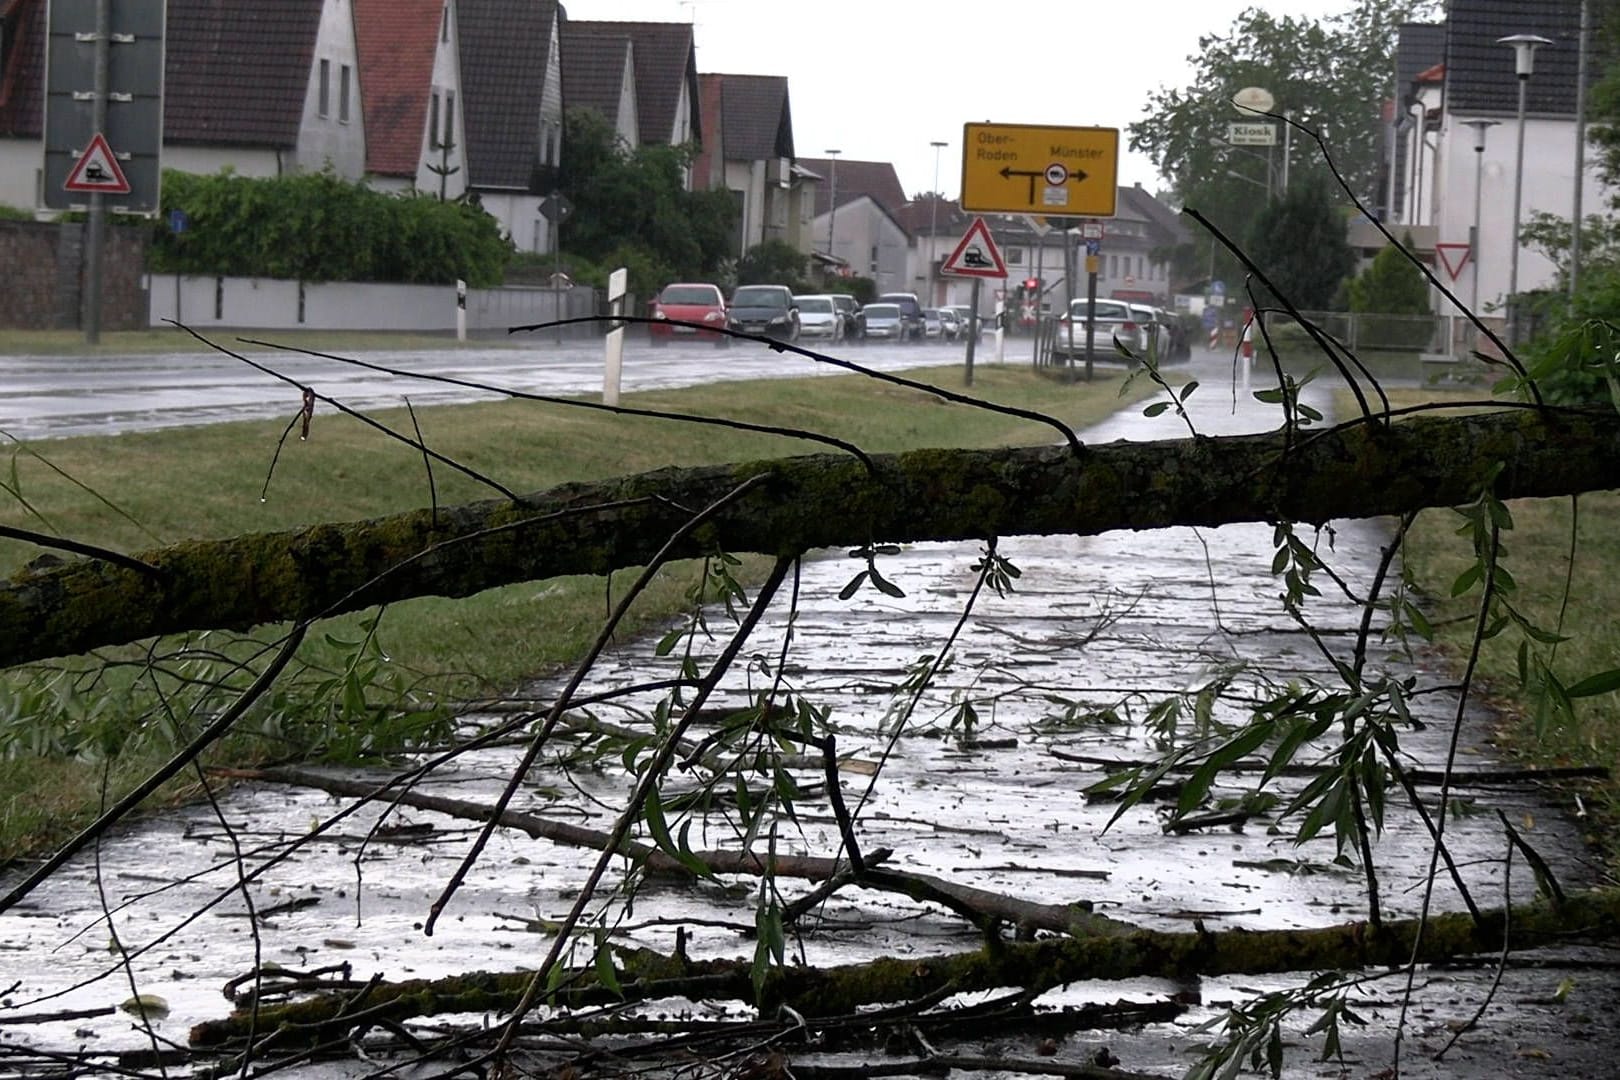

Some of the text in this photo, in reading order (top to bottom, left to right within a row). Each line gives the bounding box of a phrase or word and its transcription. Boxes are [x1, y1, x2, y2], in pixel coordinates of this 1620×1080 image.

[1234, 126, 1272, 136] Kiosk
[977, 132, 1015, 144] Ober-
[977, 148, 1018, 161] Roden
[1050, 145, 1104, 158] Münster
